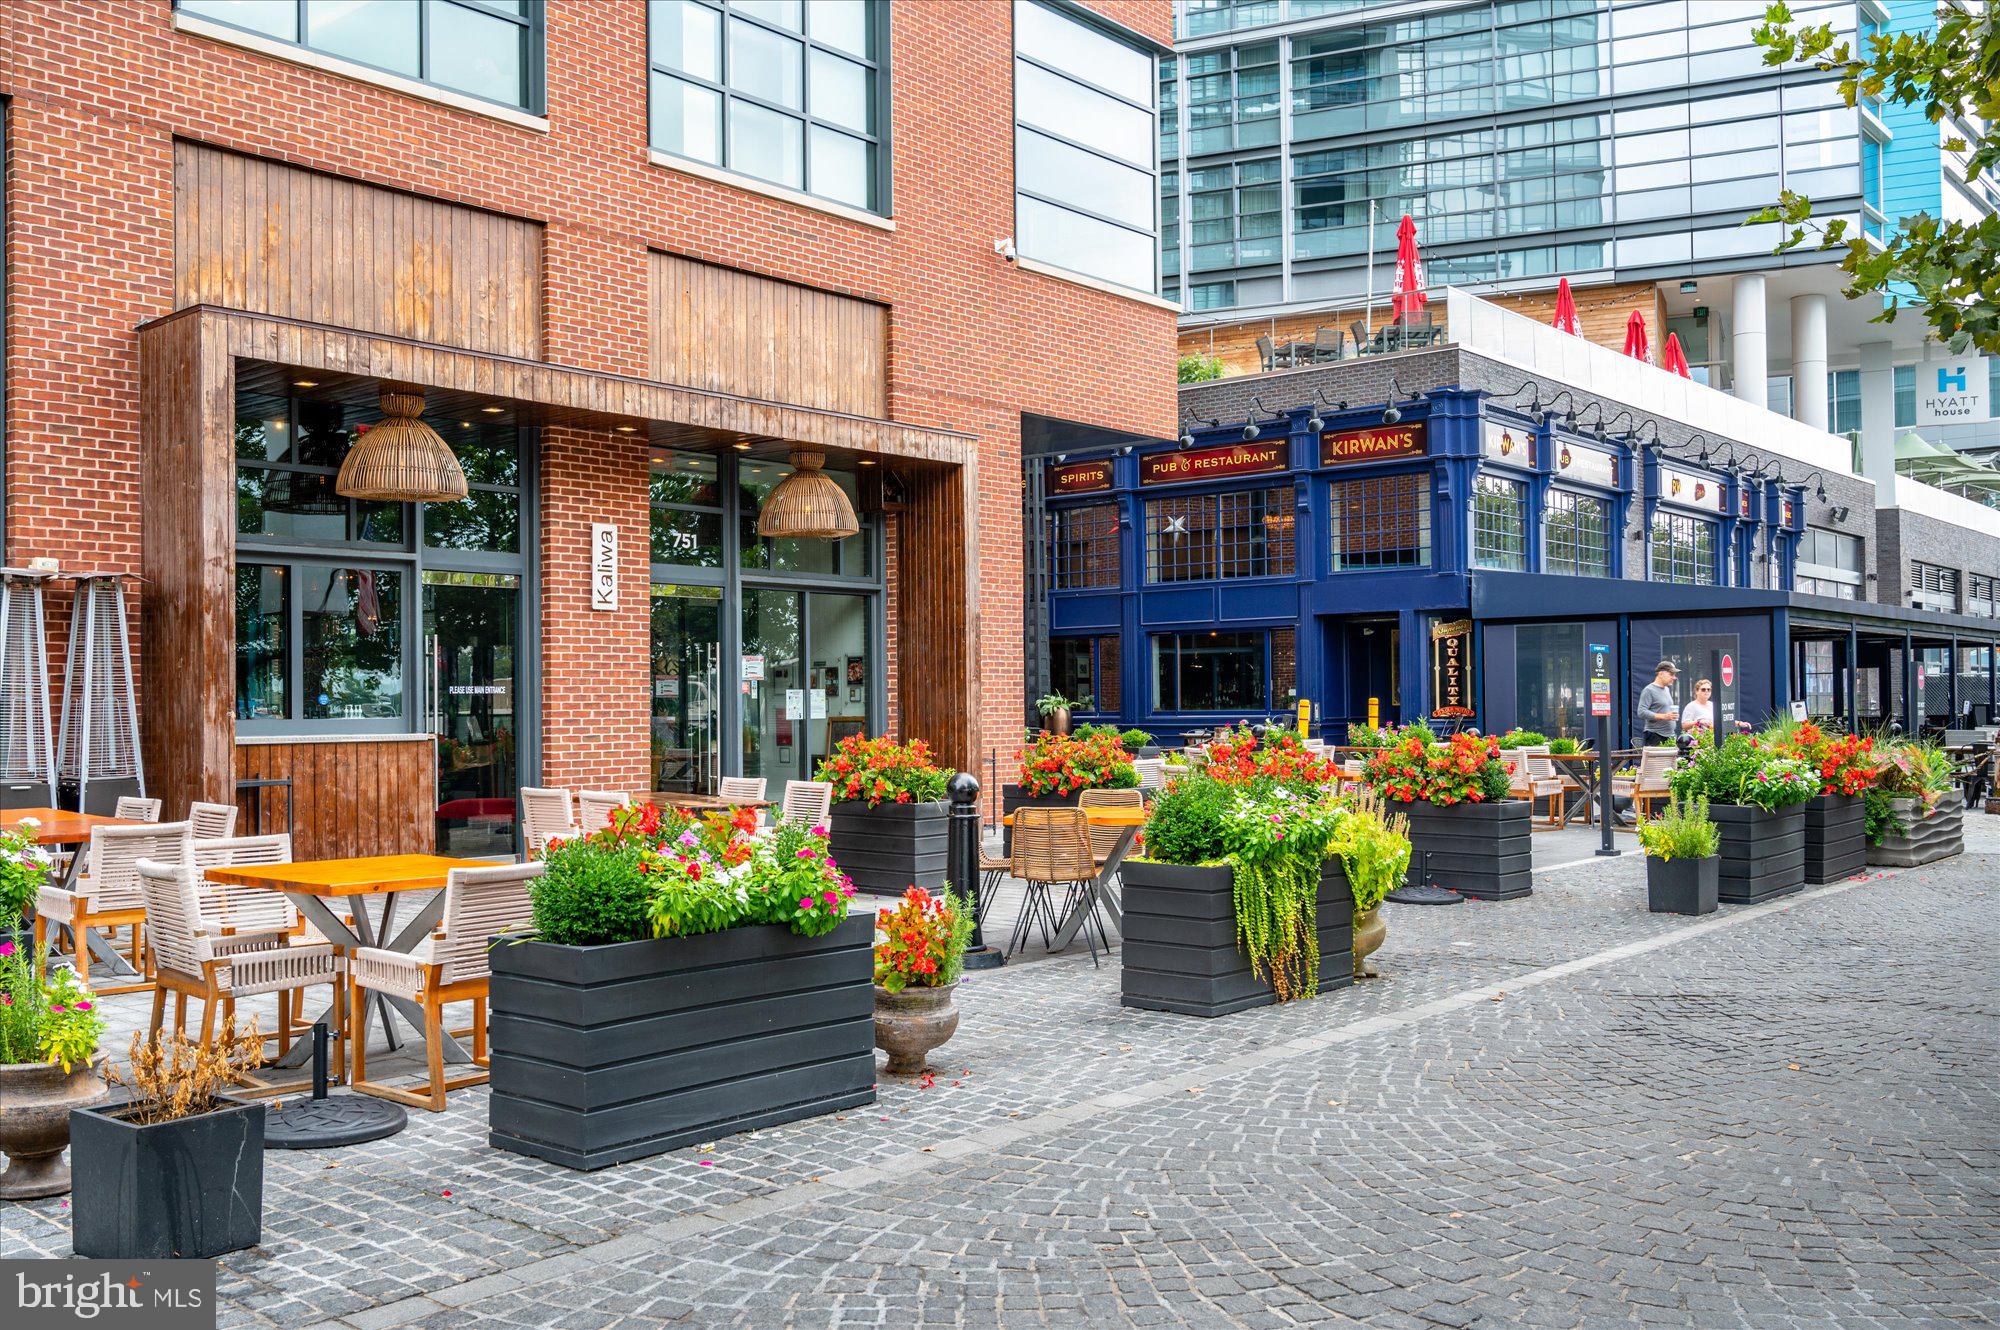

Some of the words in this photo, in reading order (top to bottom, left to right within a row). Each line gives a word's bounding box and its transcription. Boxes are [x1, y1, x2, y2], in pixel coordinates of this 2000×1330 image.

[1926, 396, 1979, 408] HYATT
[1934, 408, 1971, 416] house
[1332, 433, 1413, 456] KIRWAN'S
[1153, 462, 1177, 474] PUB
[1181, 458, 1191, 472] &
[1194, 450, 1277, 468] RESTAURANT
[1061, 471, 1104, 484] SPIRITS
[673, 533, 697, 549] 751
[597, 530, 613, 604] Kaliwa
[1446, 638, 1459, 705] QUALITY
[449, 686, 465, 694] PLEASE
[466, 686, 474, 694] USE
[474, 686, 484, 694] MAIN
[485, 686, 506, 694] ENTRANCE
[1723, 713, 1734, 721] ENTER
